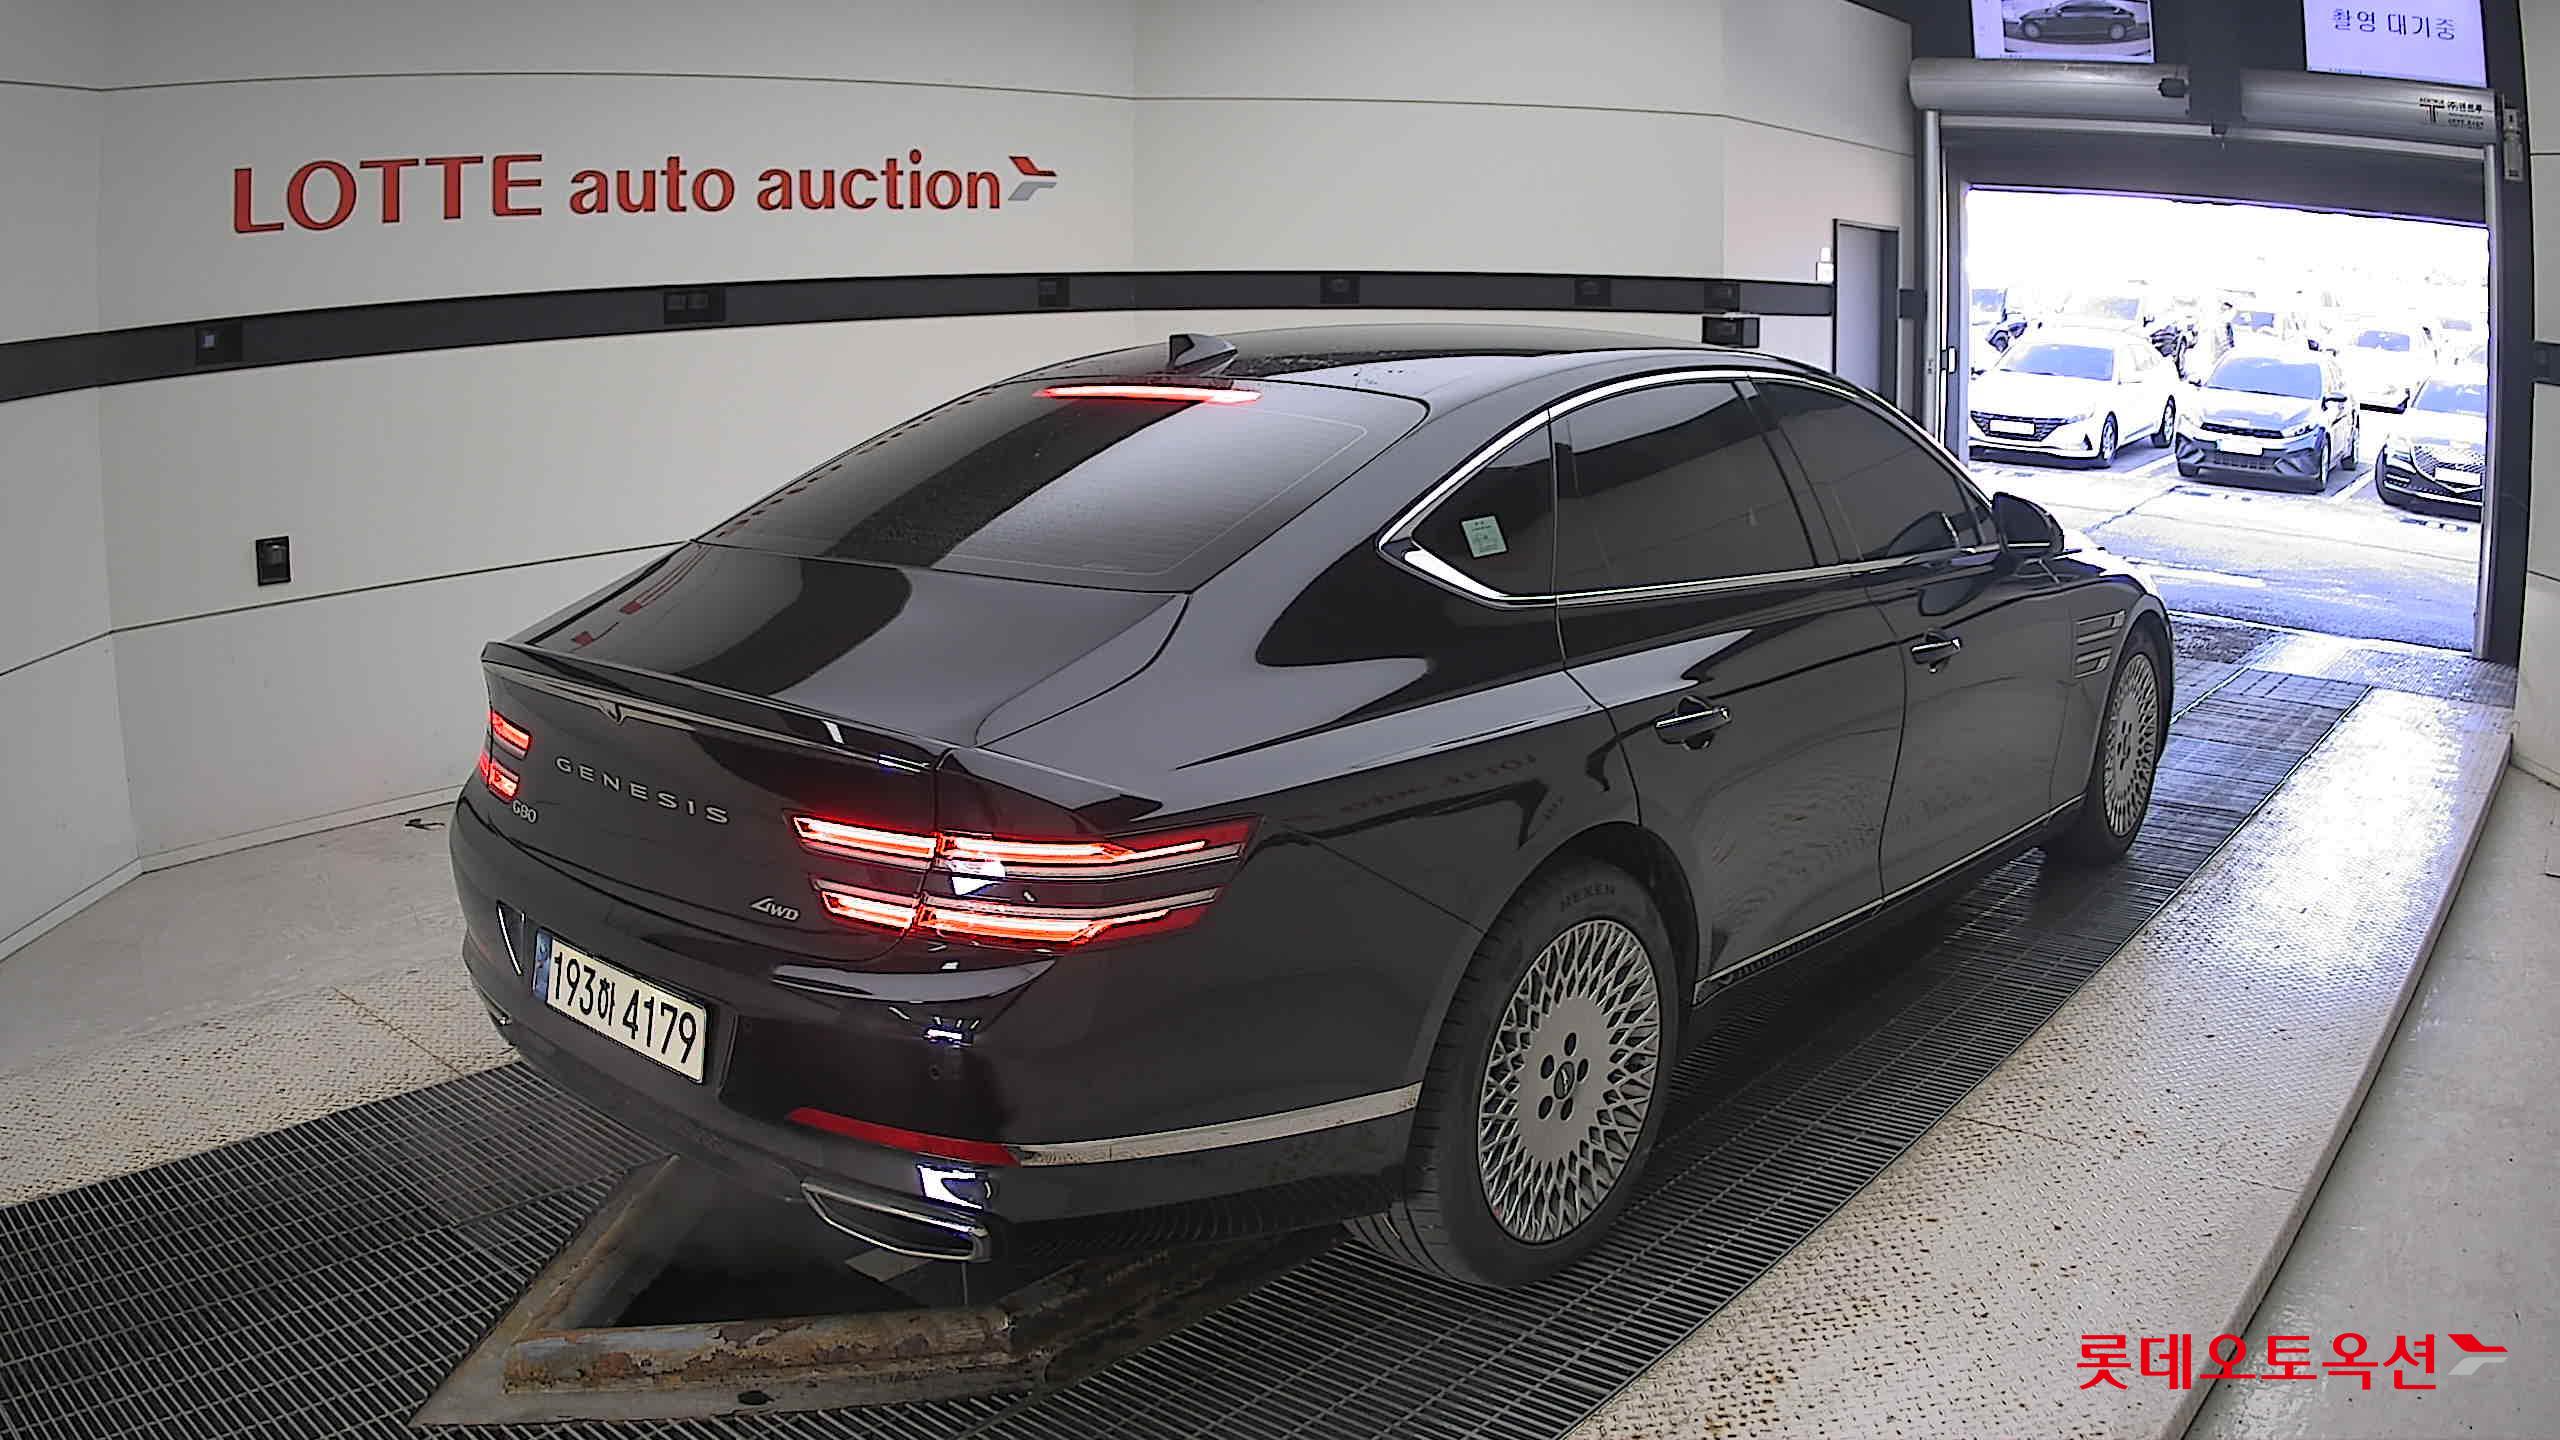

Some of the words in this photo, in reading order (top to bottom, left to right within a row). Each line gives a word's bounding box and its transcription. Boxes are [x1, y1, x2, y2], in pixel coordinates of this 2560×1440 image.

[2387, 13, 2456, 41] 대기중
[233, 153, 543, 234] LOTTE
[569, 156, 736, 214] auto
[756, 148, 1001, 211] auction
[511, 800, 537, 823] G80
[555, 756, 729, 825] GENESIS
[750, 897, 800, 922] 4WD
[553, 951, 616, 1027] 193하
[622, 989, 698, 1065] 4179
